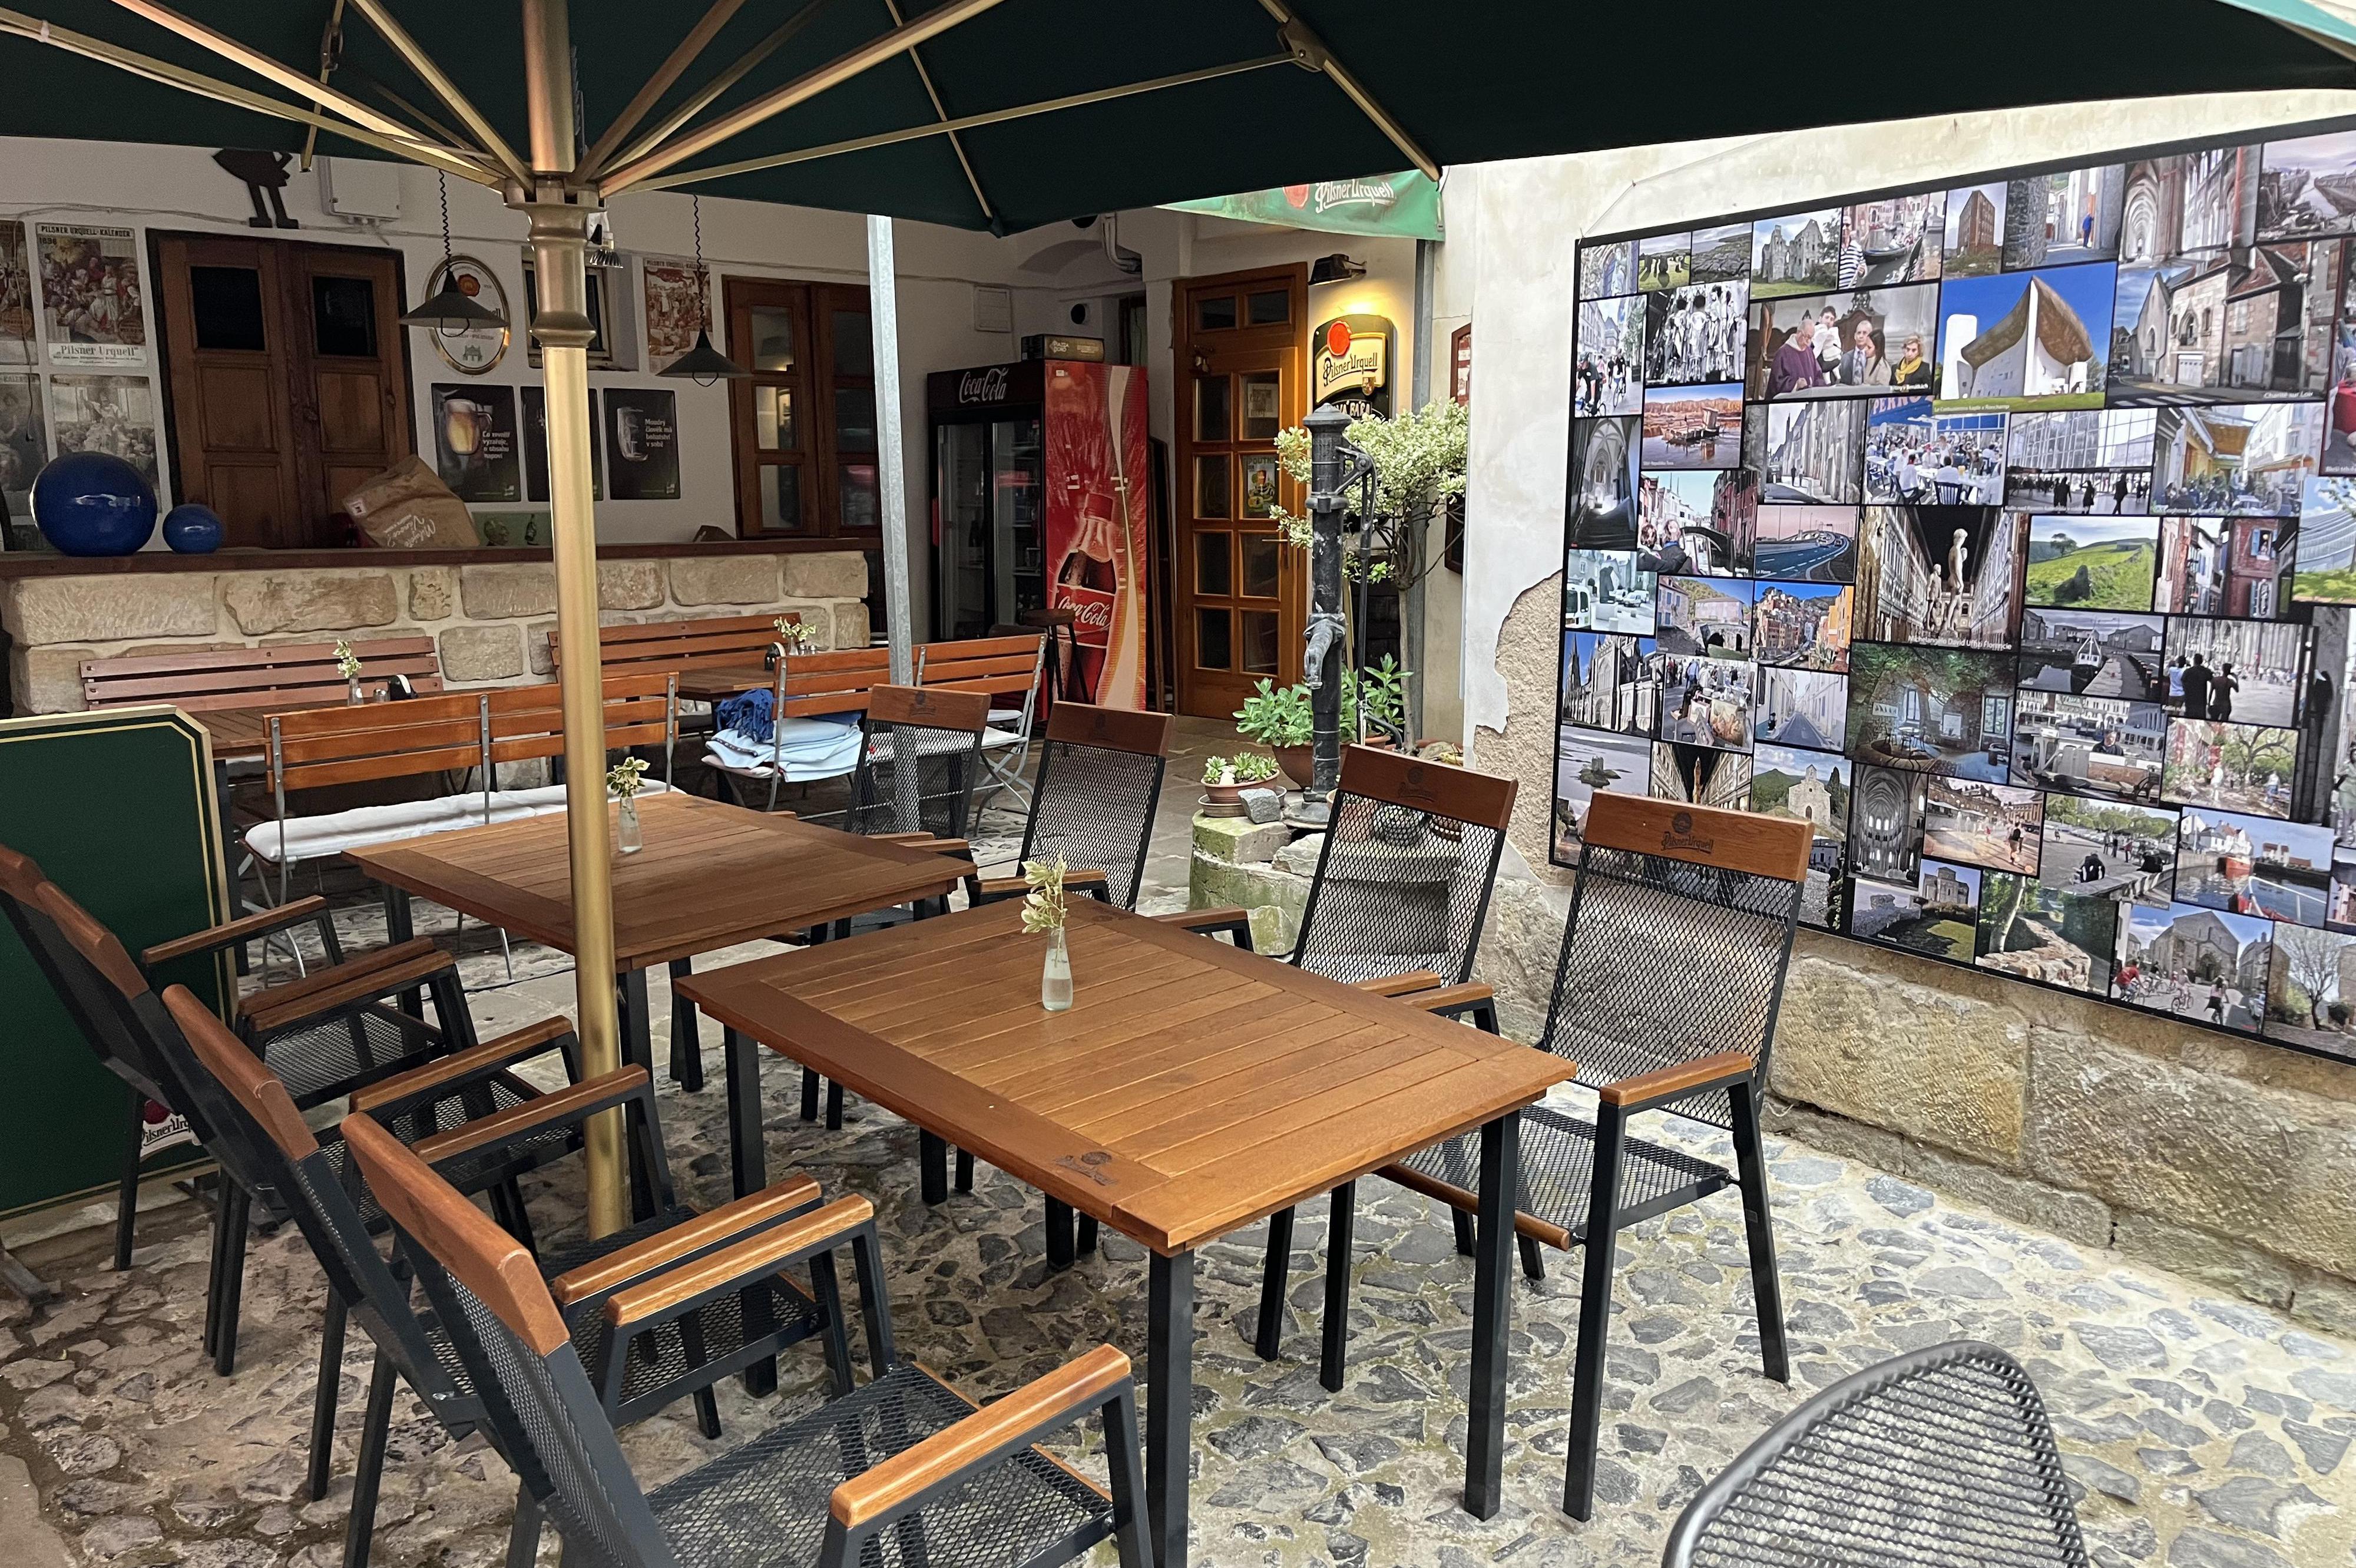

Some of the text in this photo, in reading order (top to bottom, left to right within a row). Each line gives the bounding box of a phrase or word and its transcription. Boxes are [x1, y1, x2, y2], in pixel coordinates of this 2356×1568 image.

[1315, 178, 1395, 214] Pilsner Urquell
[41, 226, 69, 234] PILSNER
[1323, 352, 1378, 387] Pilsner Urquell
[142, 1124, 172, 1143] ilsner
